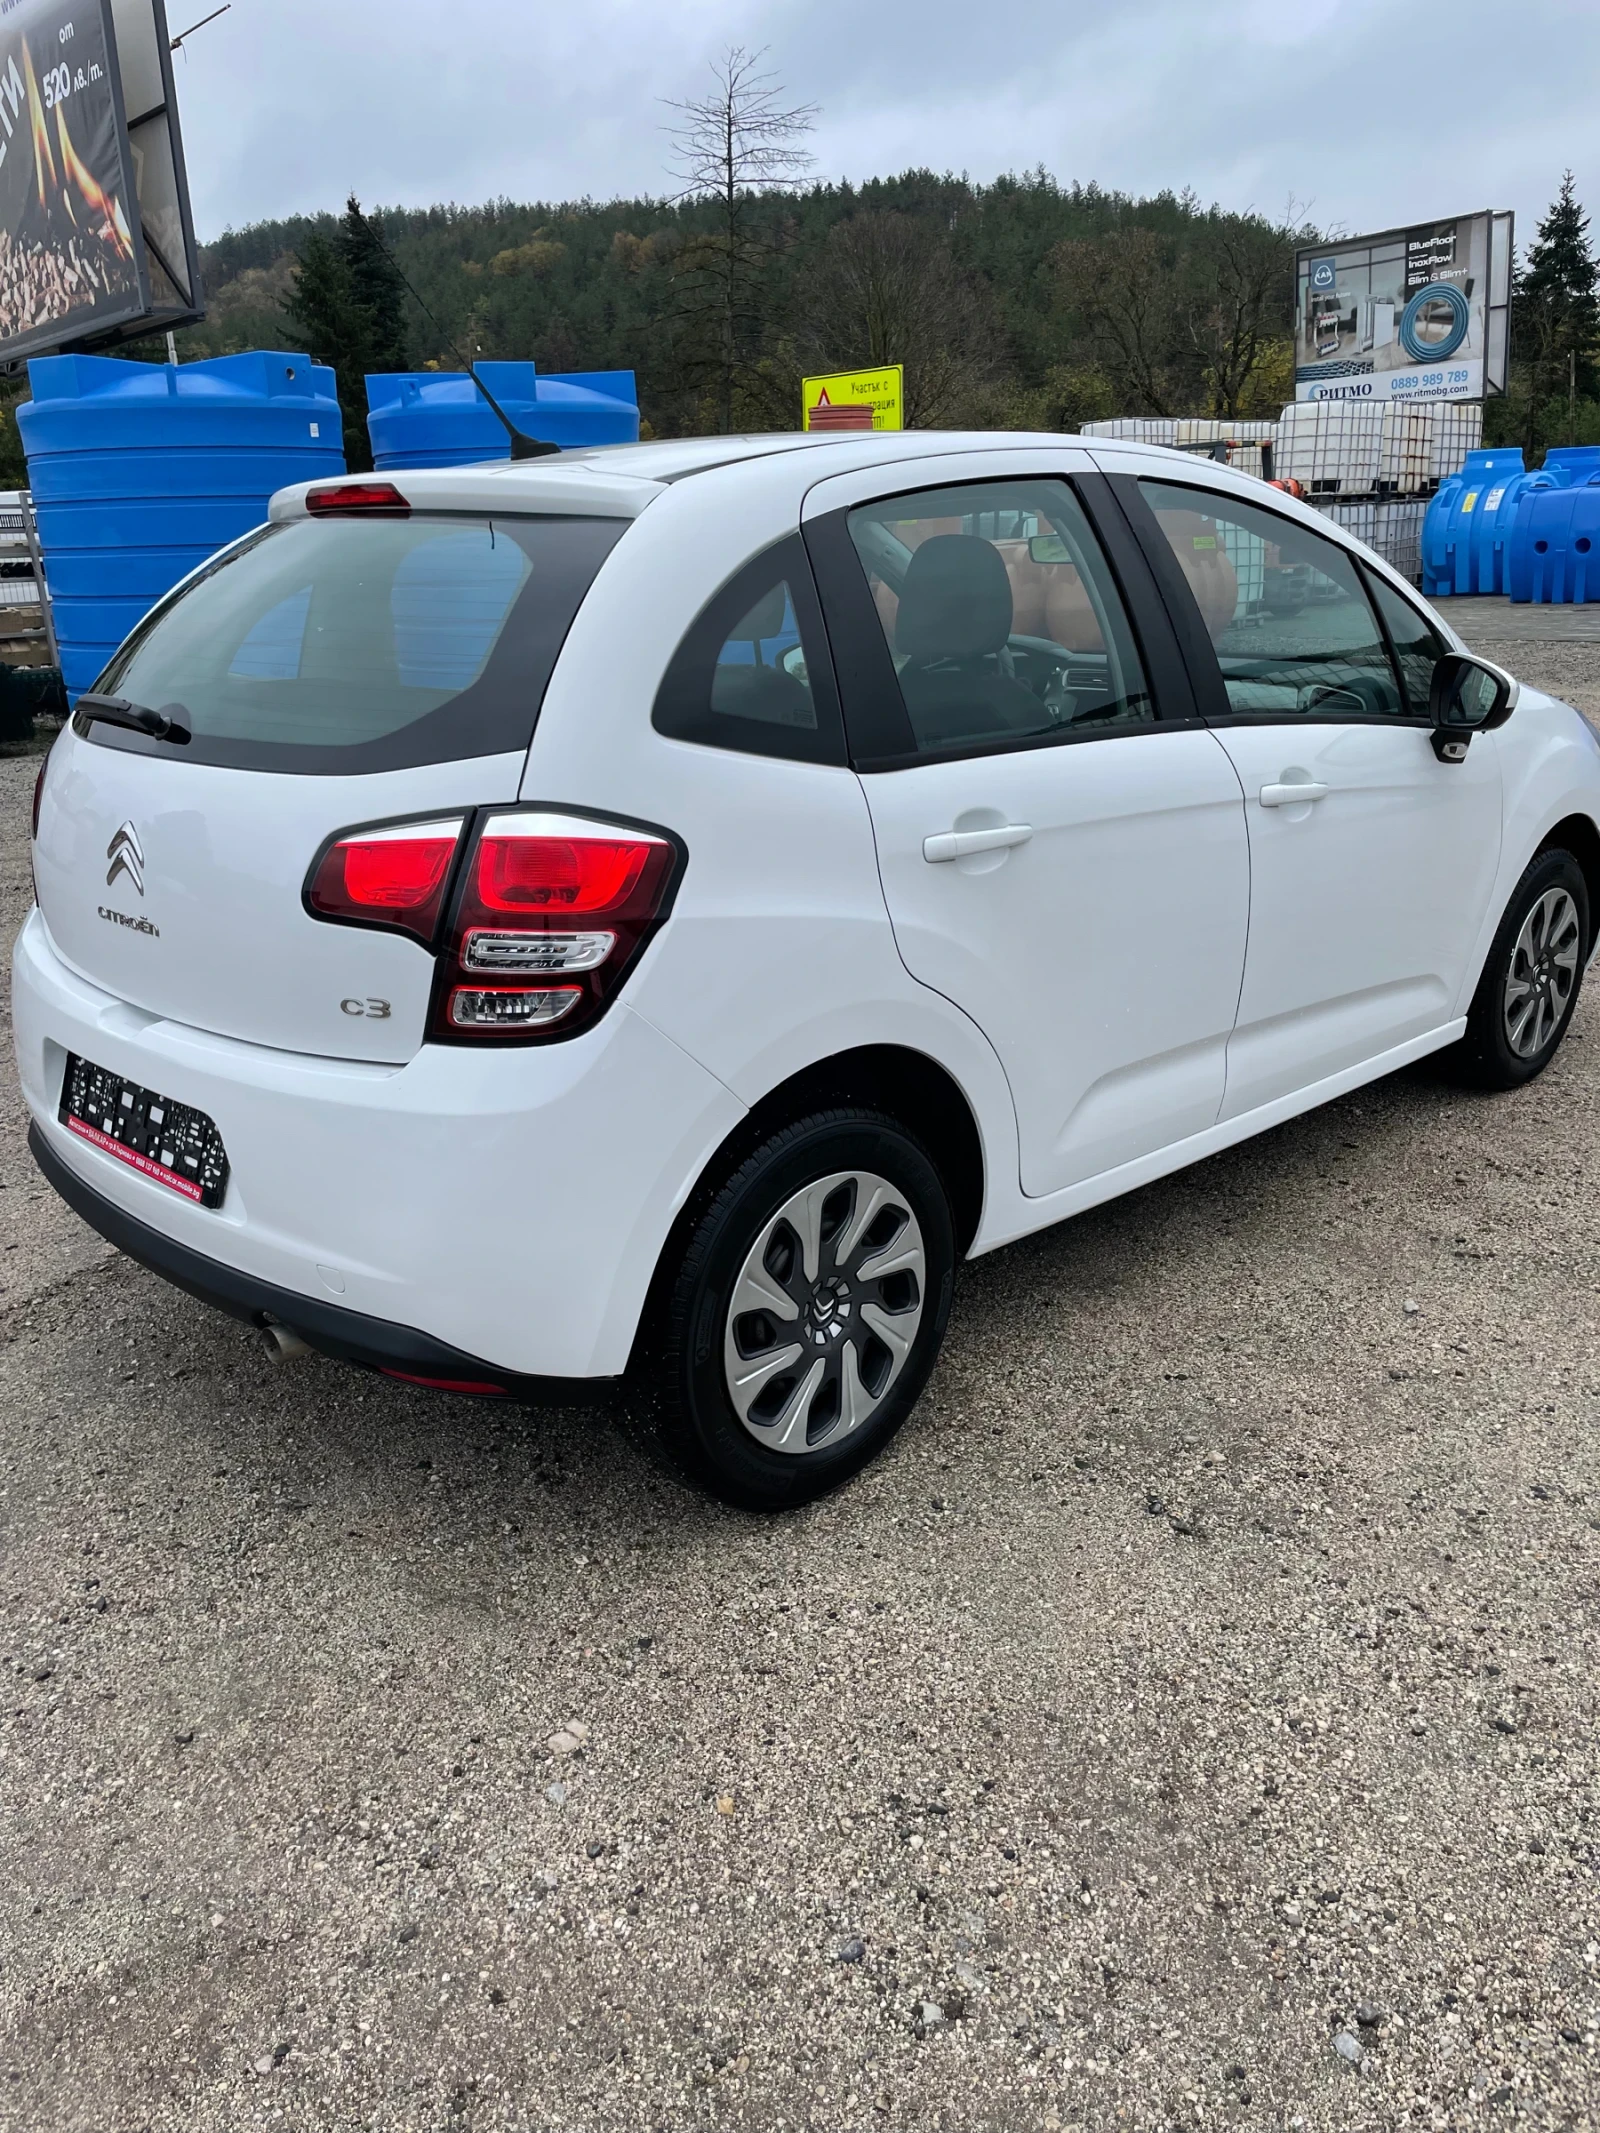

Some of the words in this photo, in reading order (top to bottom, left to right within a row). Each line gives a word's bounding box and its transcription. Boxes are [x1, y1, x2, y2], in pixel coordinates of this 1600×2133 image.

[43, 62, 71, 109] 520
[1409, 236, 1457, 251] BlueFloor
[1408, 255, 1452, 269] InoxFlow
[1408, 275, 1429, 286] Slim
[1430, 272, 1439, 282] &
[1440, 267, 1468, 280] Slim+
[851, 382, 880, 395] Участък
[1391, 376, 1419, 390] 0889
[1422, 373, 1443, 387] 989
[1447, 370, 1469, 383] 789
[1319, 383, 1372, 400] РИТМО
[1391, 384, 1469, 400] www.ritmobg.com
[97, 906, 160, 938] CITROËN
[340, 997, 391, 1019] C3
